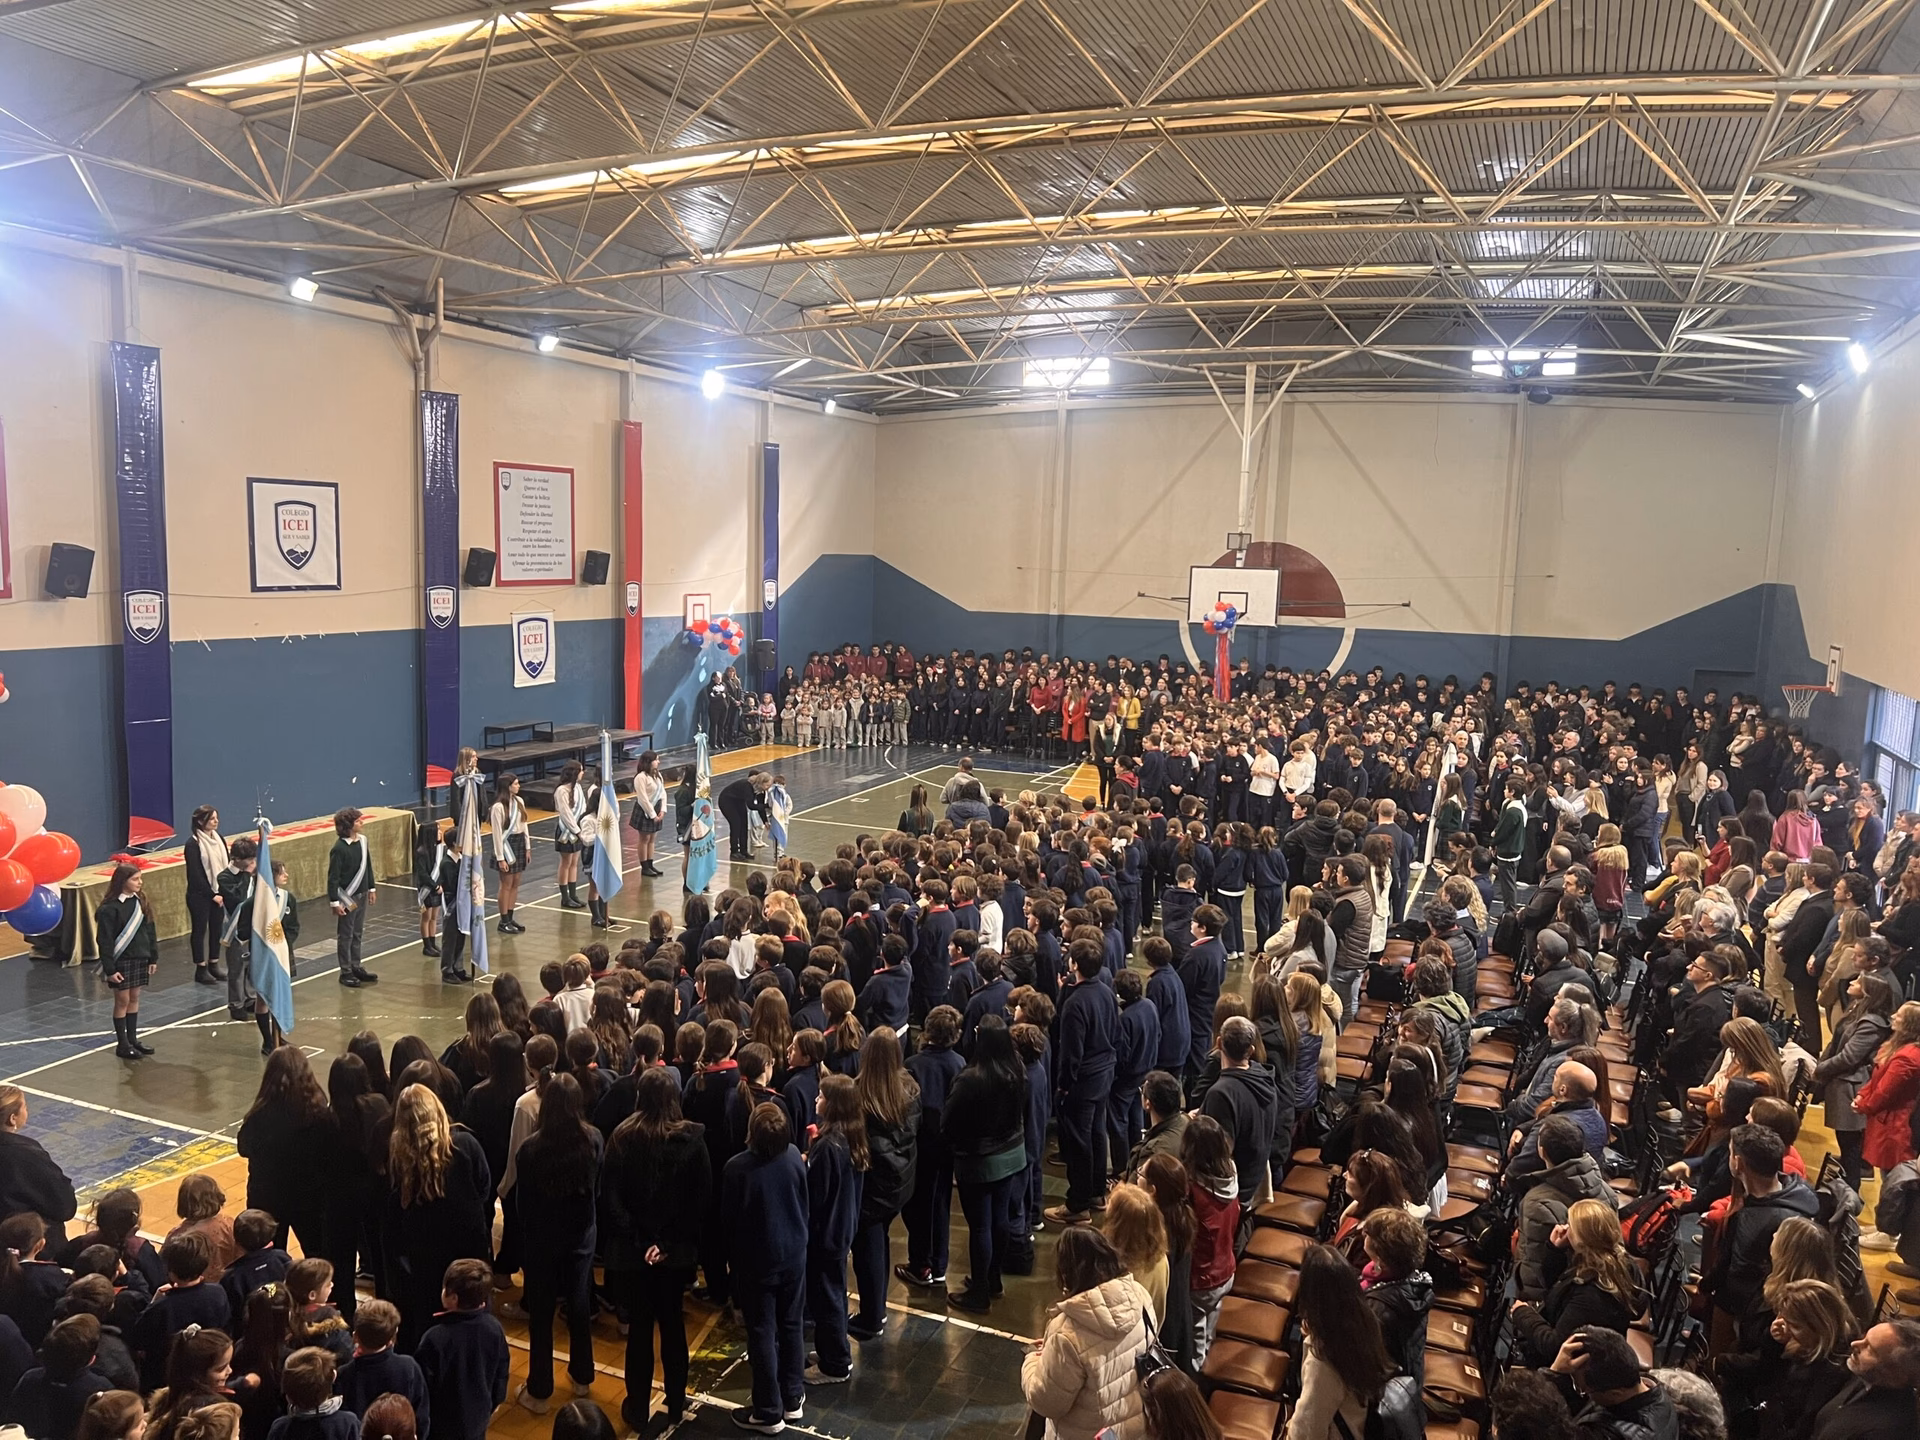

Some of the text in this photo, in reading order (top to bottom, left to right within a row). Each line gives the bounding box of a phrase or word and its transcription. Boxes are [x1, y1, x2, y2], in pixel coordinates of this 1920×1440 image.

[283, 519, 309, 531] ICEI
[133, 605, 156, 614] ICEI
[523, 633, 543, 645] ICEI
